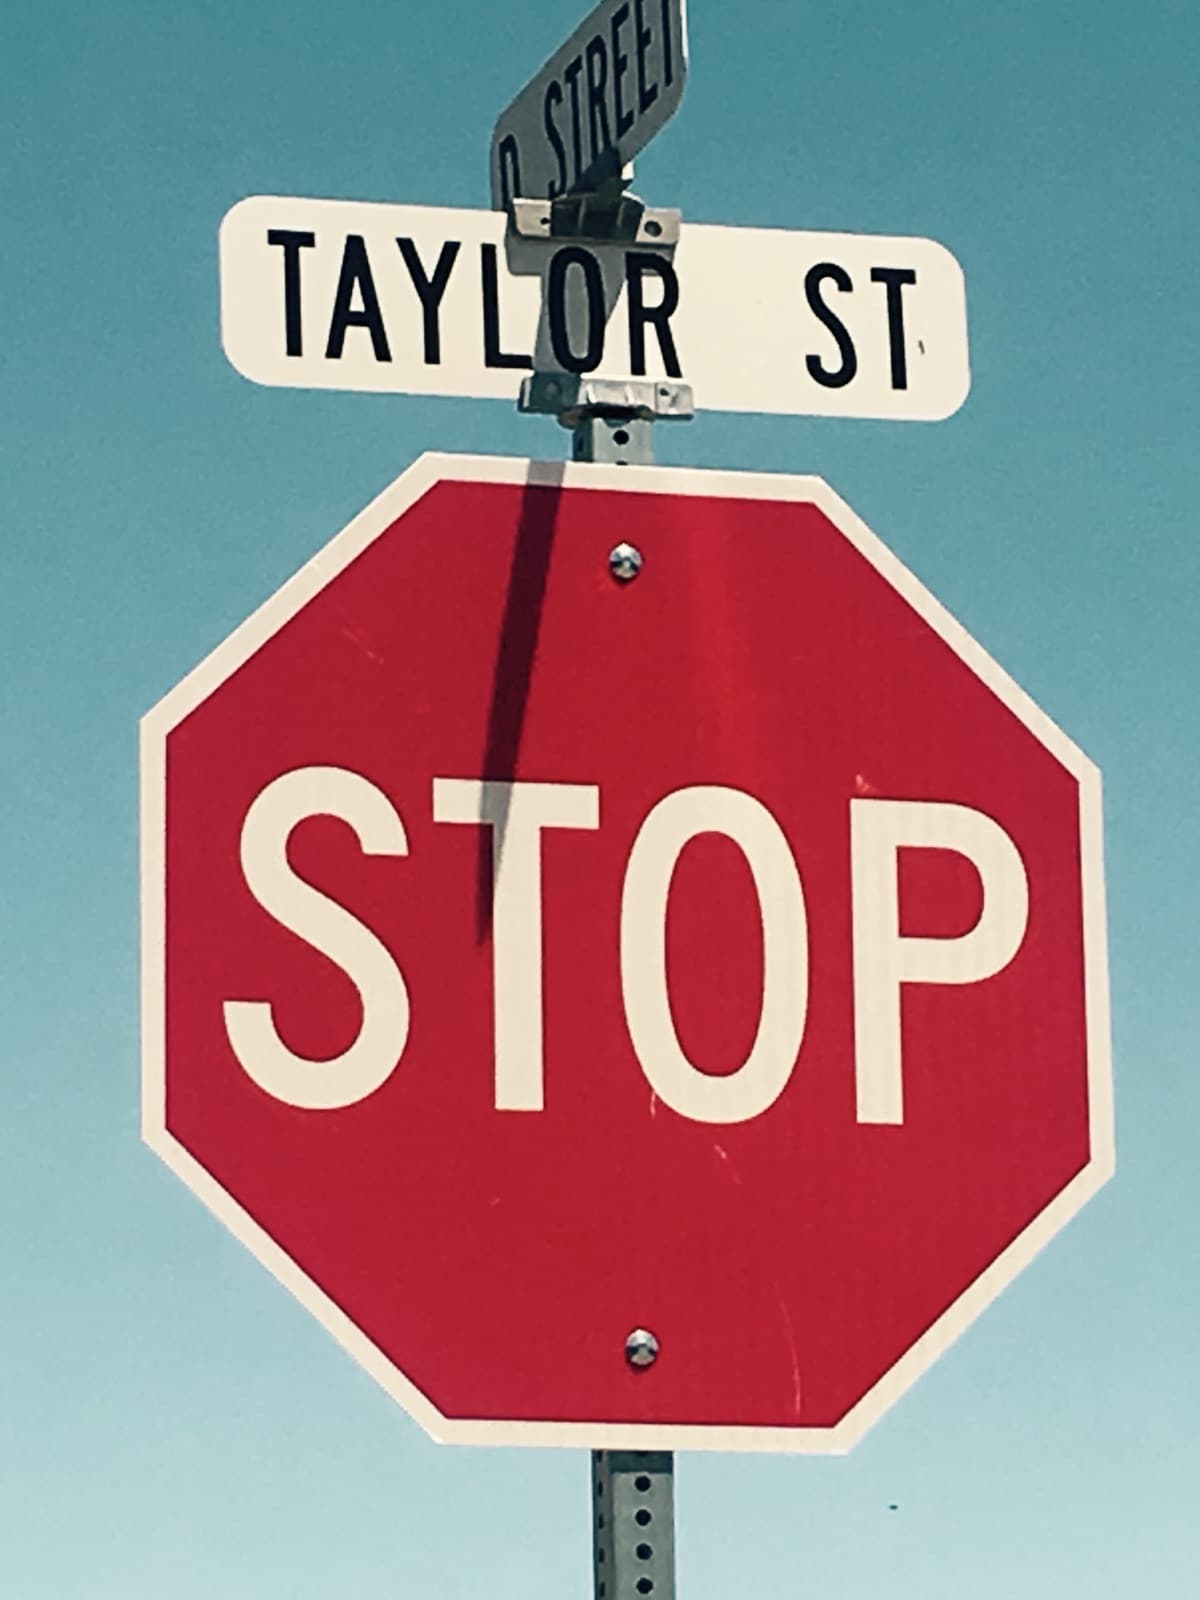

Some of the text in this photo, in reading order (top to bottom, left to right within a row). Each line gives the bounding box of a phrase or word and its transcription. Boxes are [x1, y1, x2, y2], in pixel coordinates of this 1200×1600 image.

[267, 229, 917, 390] TAYLOR ST
[223, 766, 1029, 1125] STOP
